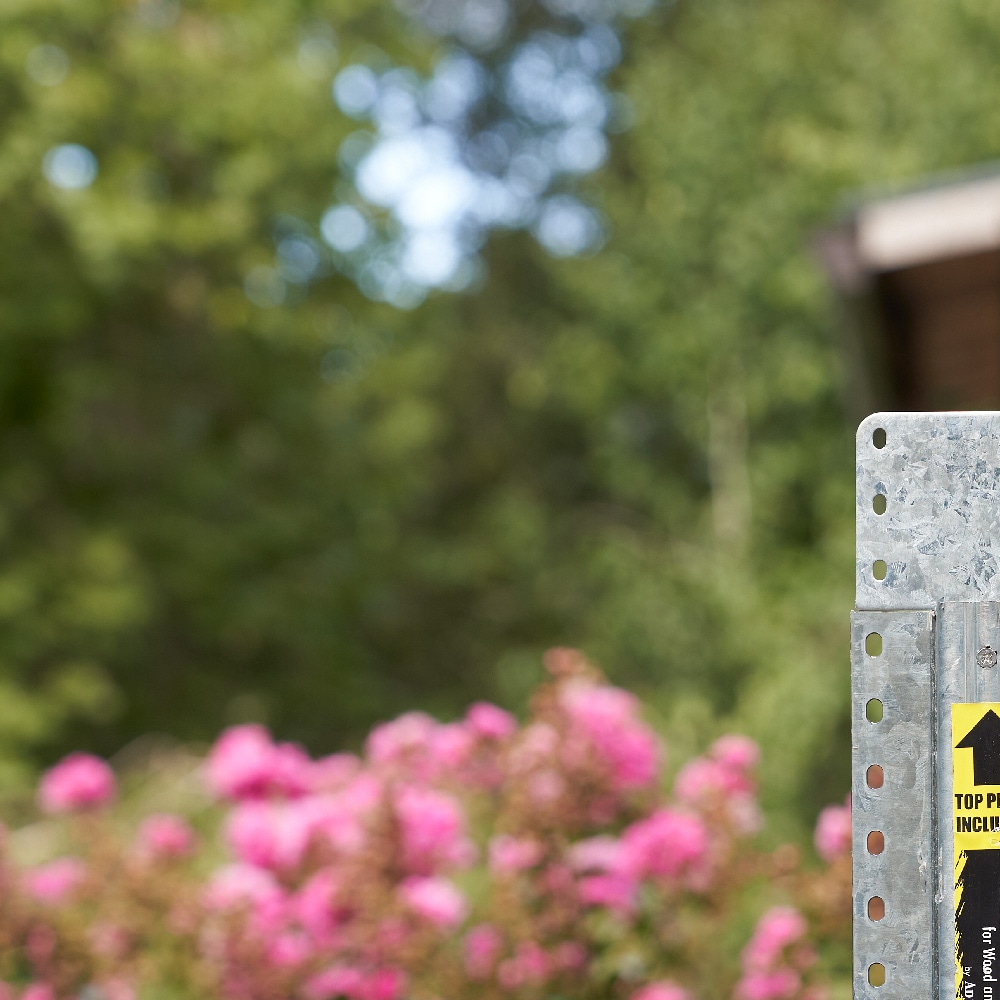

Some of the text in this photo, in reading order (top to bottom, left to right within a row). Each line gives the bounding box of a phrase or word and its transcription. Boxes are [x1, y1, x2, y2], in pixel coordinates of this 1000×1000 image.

[955, 793, 983, 810] TOP
[982, 926, 997, 944] for
[963, 966, 972, 976] by
[982, 948, 997, 982] Wood
